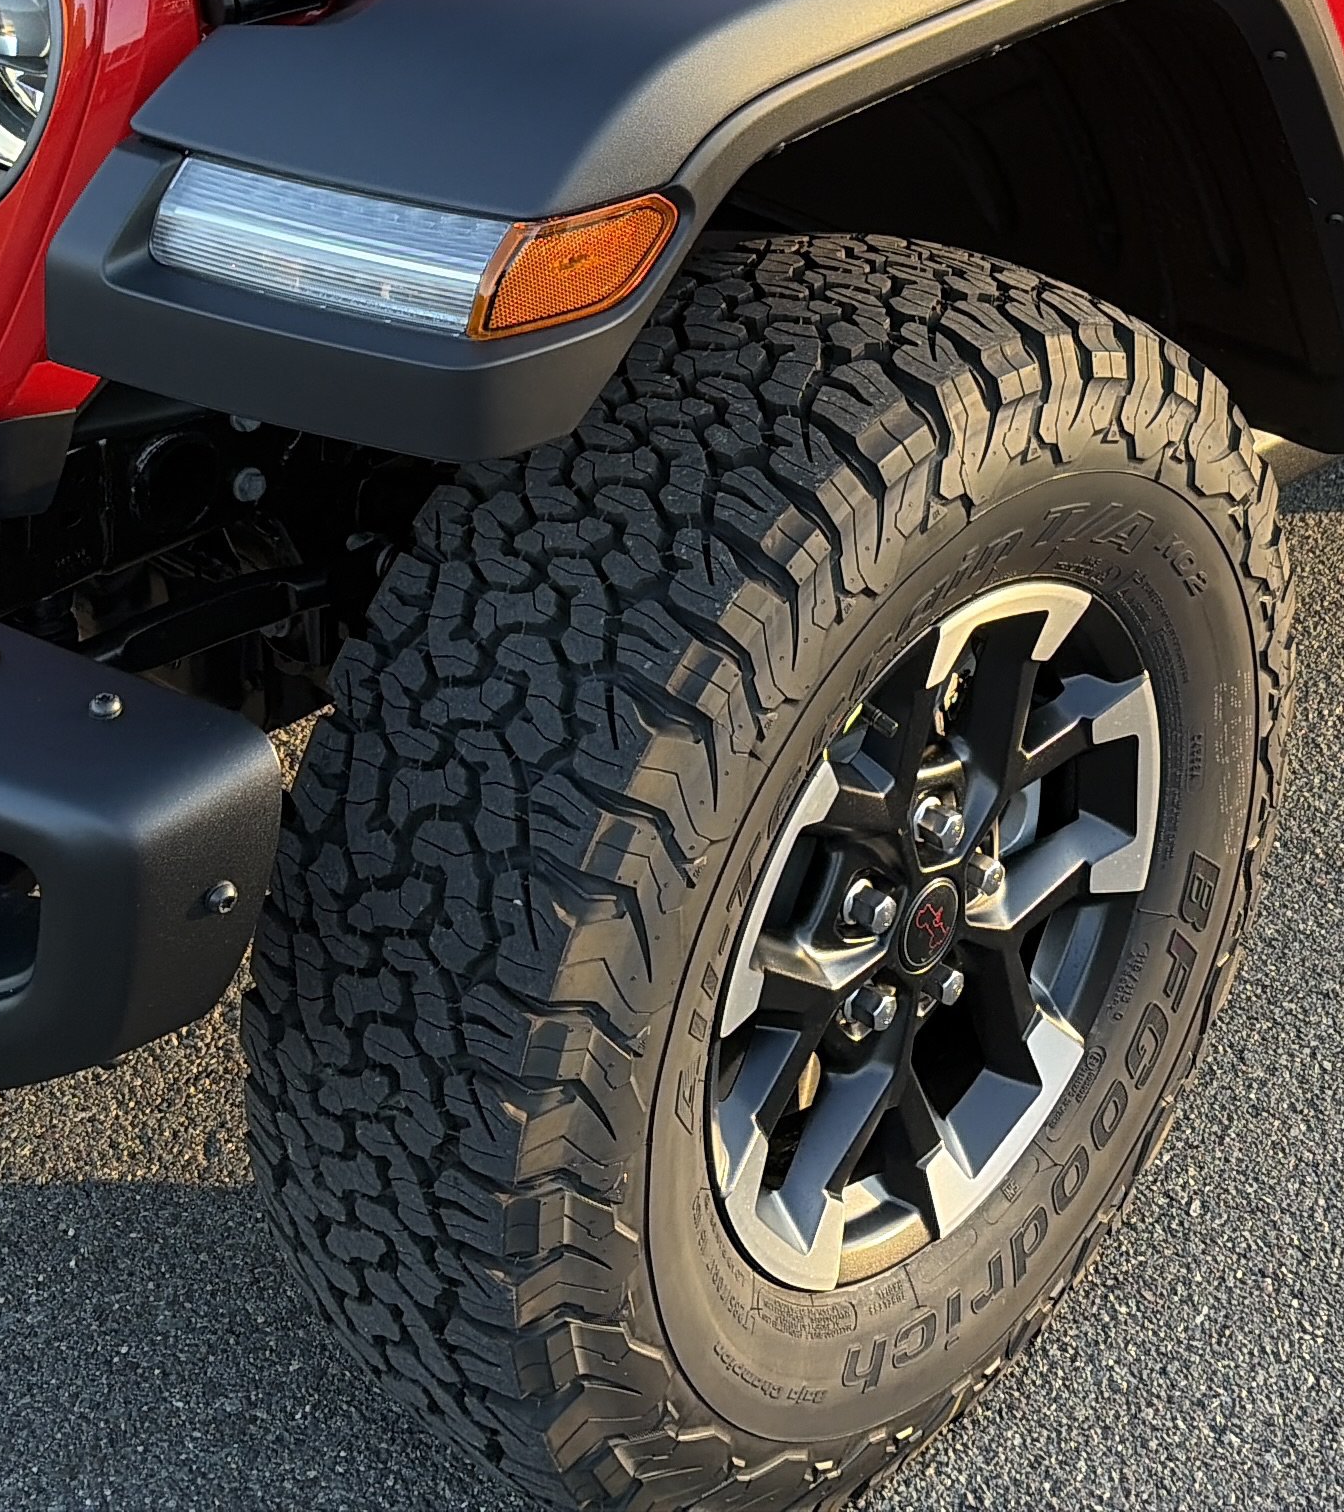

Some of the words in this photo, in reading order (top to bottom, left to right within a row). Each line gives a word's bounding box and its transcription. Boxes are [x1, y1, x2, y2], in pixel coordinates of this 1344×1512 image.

[1032, 501, 1156, 554] T/A
[839, 850, 1234, 1392] BFGoodrich
[708, 1339, 782, 1401] Champion
[782, 1380, 829, 1407] Baja
